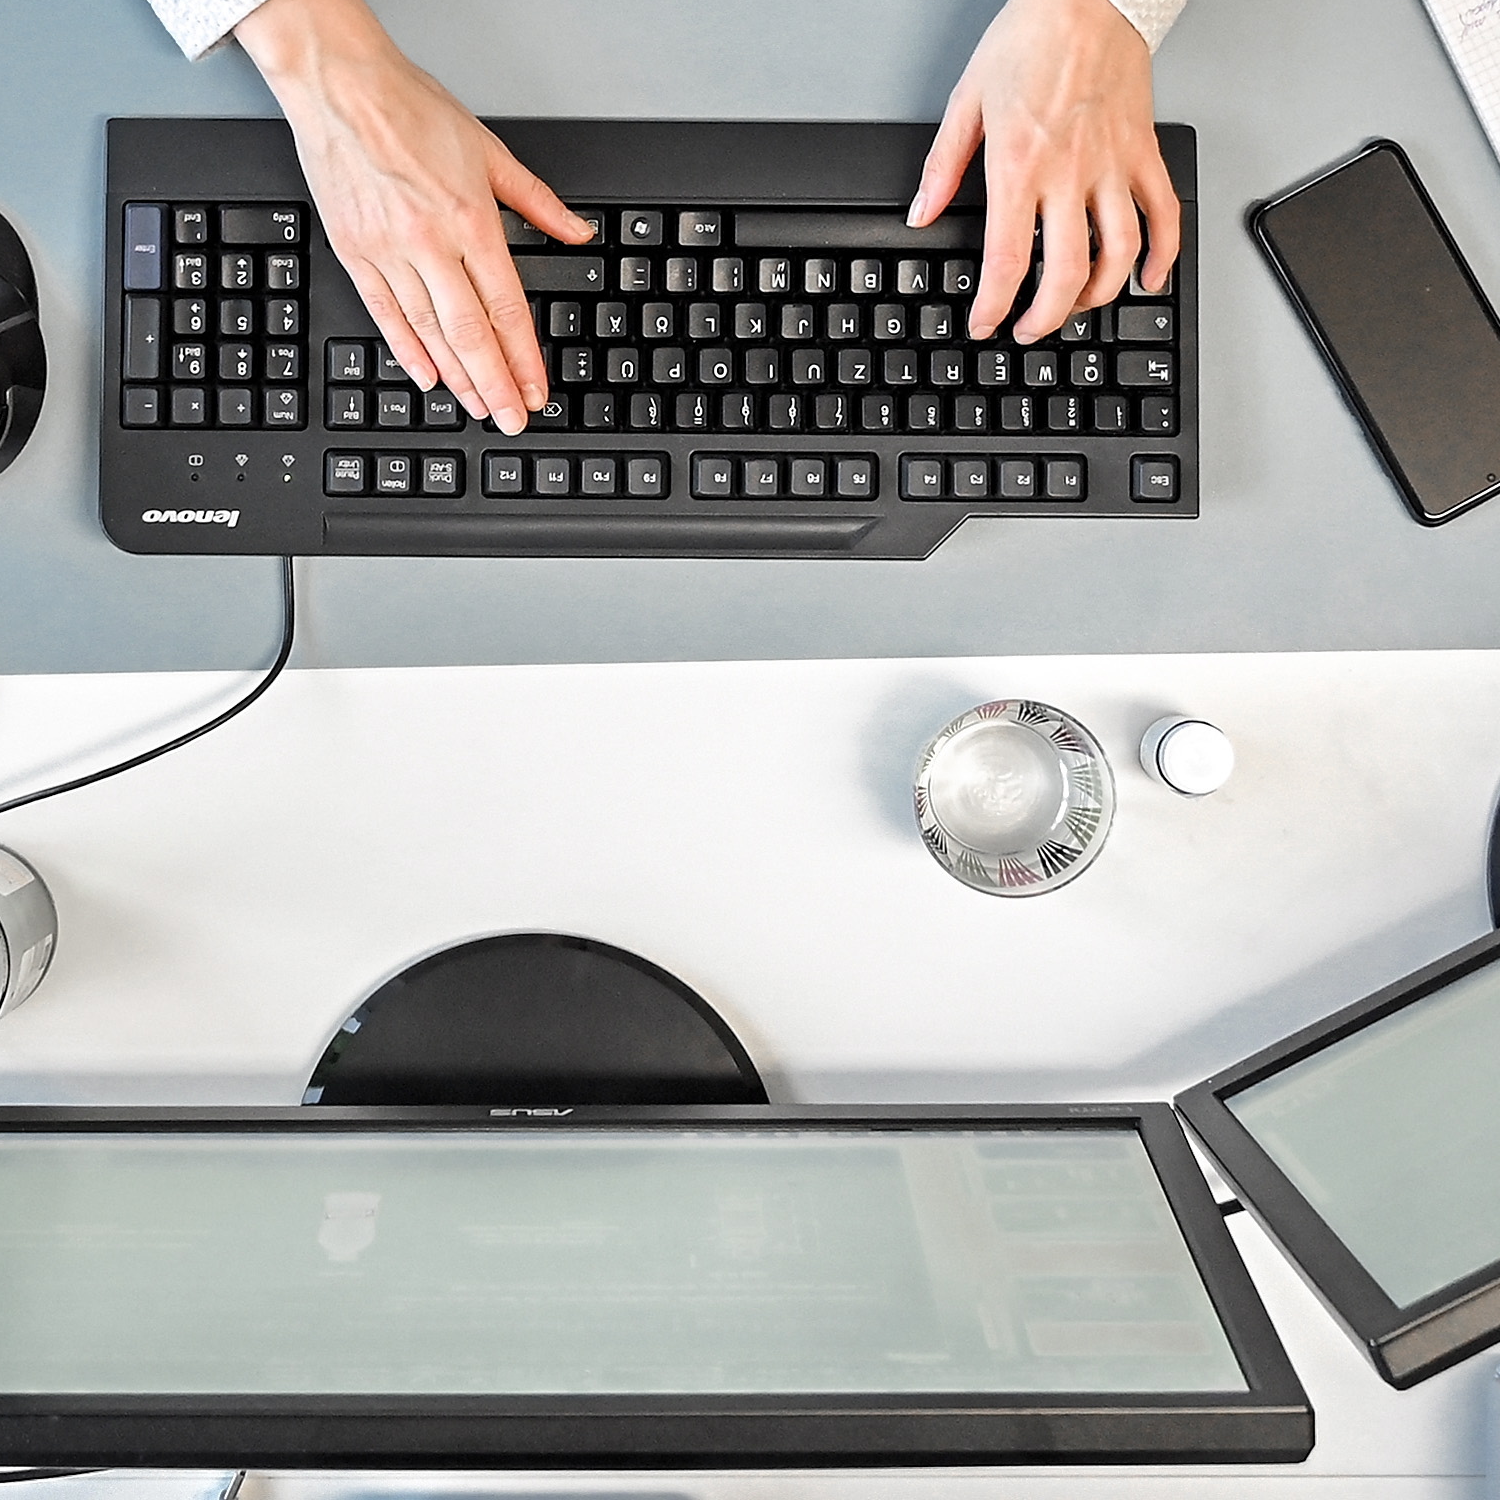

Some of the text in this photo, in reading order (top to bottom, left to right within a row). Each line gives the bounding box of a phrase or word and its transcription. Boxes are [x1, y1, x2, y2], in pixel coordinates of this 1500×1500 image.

[183, 213, 201, 222] Entf
[272, 212, 294, 222] Einfg
[283, 226, 294, 239] 0
[134, 243, 155, 253] Enter
[185, 257, 201, 266] Bild
[191, 270, 201, 283] 3
[236, 270, 247, 283] 2
[284, 270, 292, 283] 1
[771, 273, 785, 287] M
[818, 273, 830, 286] N
[864, 273, 876, 286] B
[911, 273, 923, 287] V
[957, 275, 970, 288] C
[190, 316, 201, 329] 6
[237, 316, 247, 329] 5
[283, 316, 293, 329] 4
[609, 315, 621, 331] Ä
[655, 315, 667, 331] Ö
[704, 317, 715, 331] L
[749, 318, 761, 332] K
[797, 318, 808, 332] J
[841, 318, 853, 332] H
[886, 318, 900, 332] G
[935, 319, 947, 333] F
[1073, 321, 1086, 335] A
[184, 347, 201, 356] Bild
[189, 359, 199, 373] 9
[237, 361, 247, 374] 8
[283, 361, 293, 374] 7
[343, 365, 359, 375] Bild
[668, 362, 680, 377] P
[807, 364, 820, 378] U
[853, 364, 865, 378] Z
[900, 364, 912, 378] T
[946, 364, 958, 378] R
[995, 365, 1005, 380] E
[1083, 365, 1098, 380] Q
[1038, 366, 1052, 380] W
[272, 410, 294, 419] Num
[342, 409, 359, 420] Bild
[391, 403, 405, 413] Pos
[427, 472, 452, 483] Druck
[499, 469, 516, 479] F12
[547, 471, 563, 481] F11
[592, 471, 609, 481] F10
[642, 472, 656, 481] F9
[714, 472, 726, 482] F8
[760, 473, 772, 482] F7
[806, 472, 819, 482] F6
[852, 472, 865, 482] F5
[923, 473, 936, 483] F4
[969, 473, 983, 483] F3
[1017, 474, 1030, 484] F2
[1064, 474, 1076, 484] F1
[1149, 474, 1169, 485] Esc
[141, 508, 239, 527] lenovo
